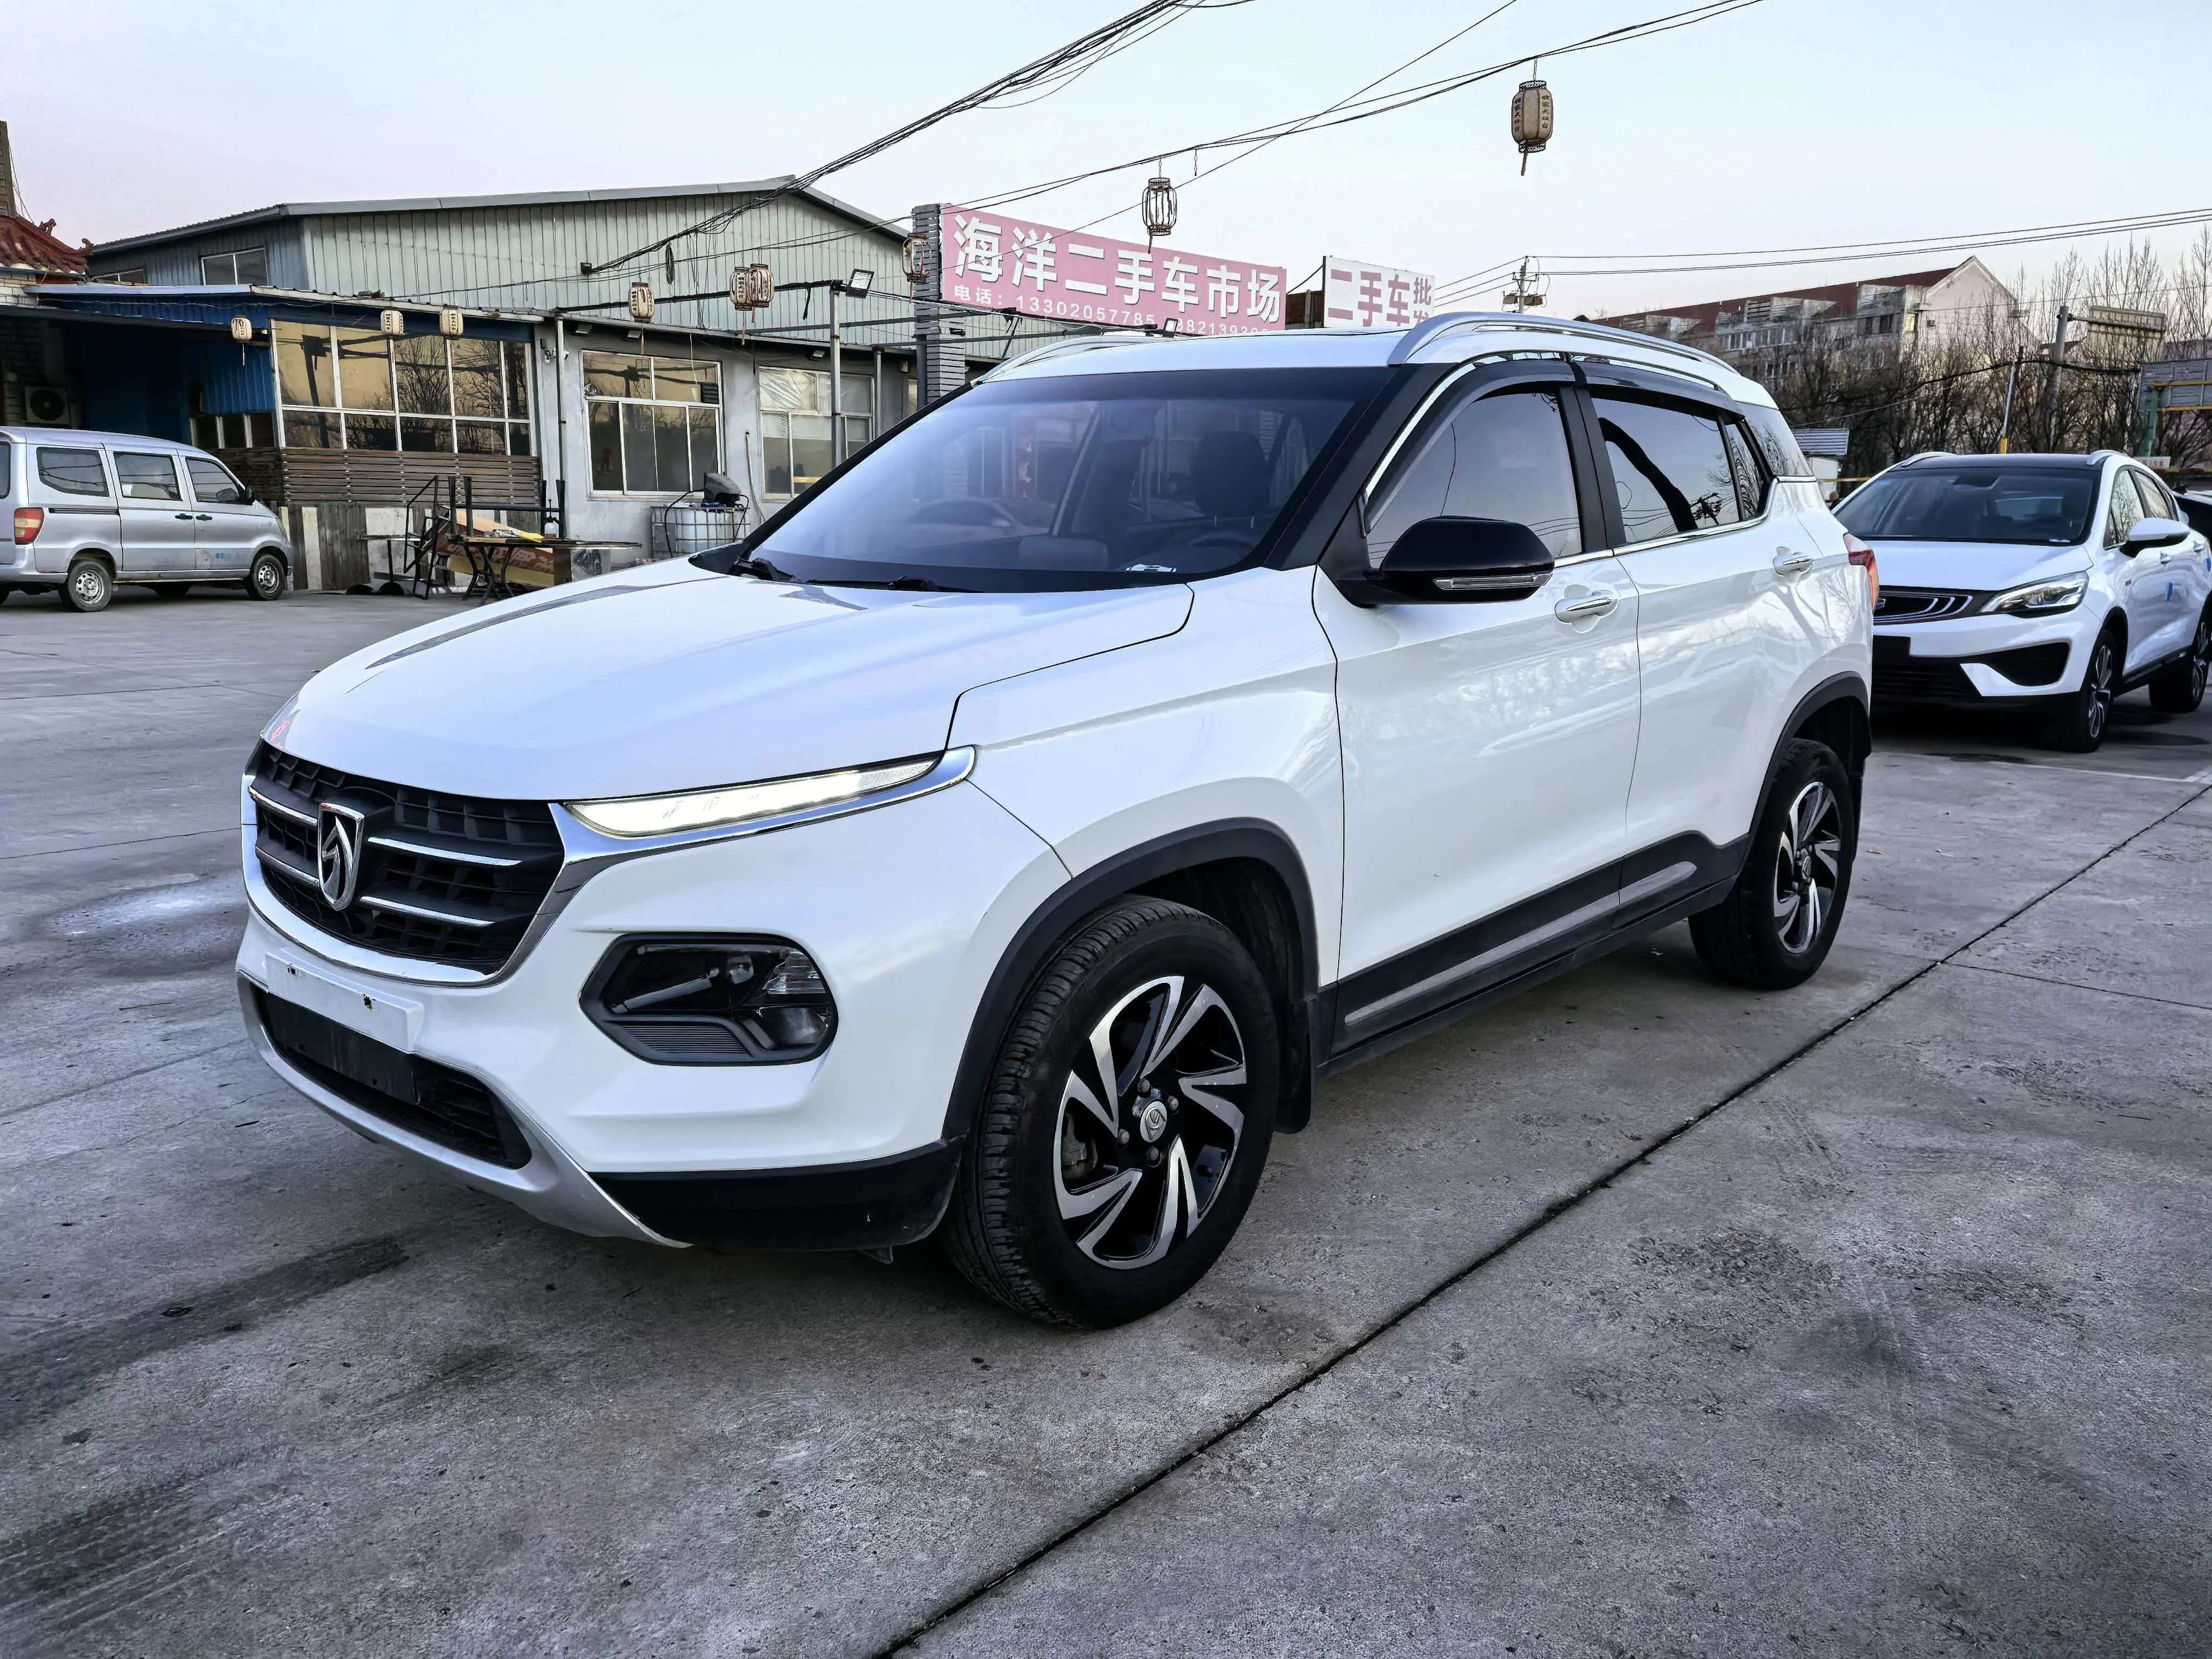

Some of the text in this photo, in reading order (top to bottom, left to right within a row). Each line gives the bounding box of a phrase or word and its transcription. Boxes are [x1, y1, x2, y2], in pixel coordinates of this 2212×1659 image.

[953, 214, 1280, 323] 海洋二手车市场
[1016, 295, 1156, 325] 13302057785
